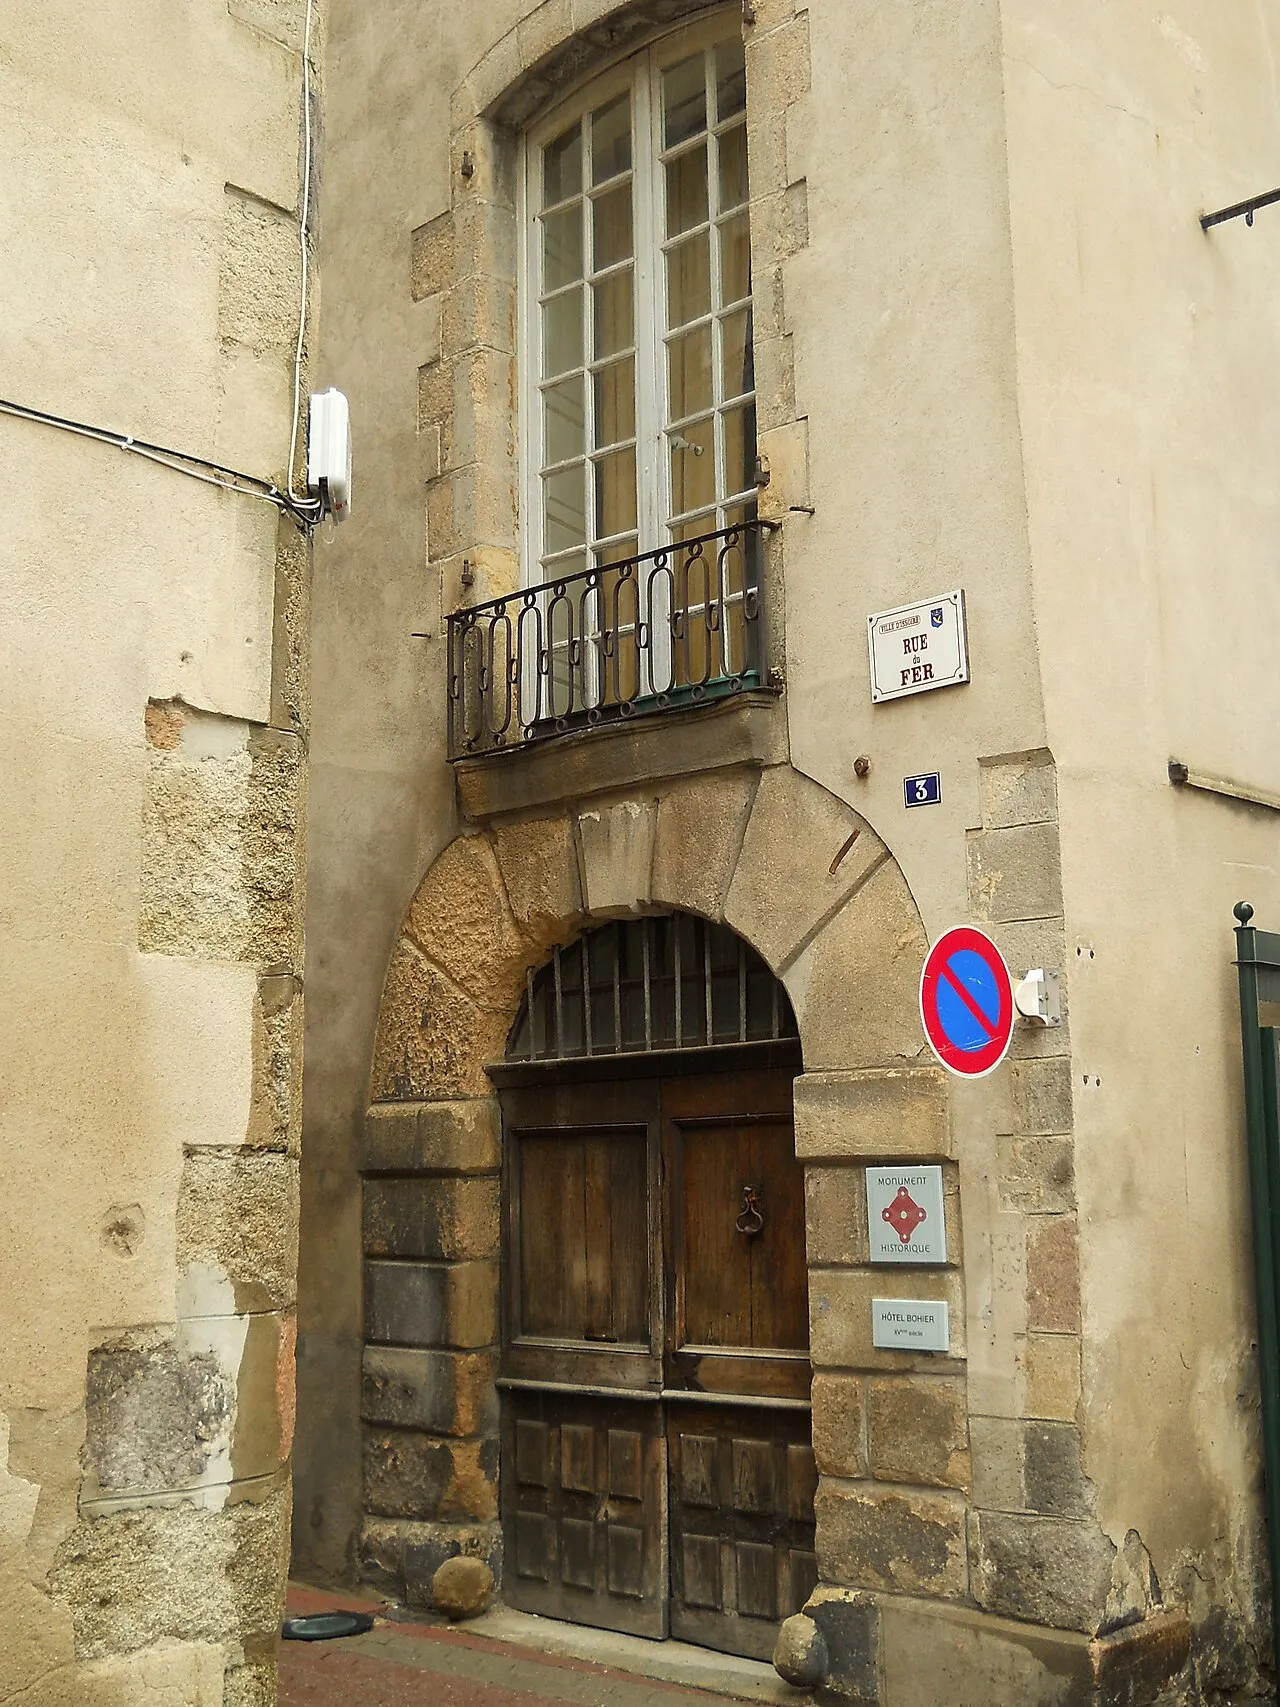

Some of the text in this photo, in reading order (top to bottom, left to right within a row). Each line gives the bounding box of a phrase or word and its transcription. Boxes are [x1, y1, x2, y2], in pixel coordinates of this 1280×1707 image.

[881, 622, 895, 632] VILLE
[903, 634, 928, 654] RUE
[913, 655, 920, 664] du
[900, 663, 934, 686] FER
[915, 779, 928, 800] 3
[878, 1177, 927, 1186] MONUMENT
[881, 1244, 931, 1253] HISTORIQUE
[881, 1312, 935, 1323] HÔTEL BOHIER
